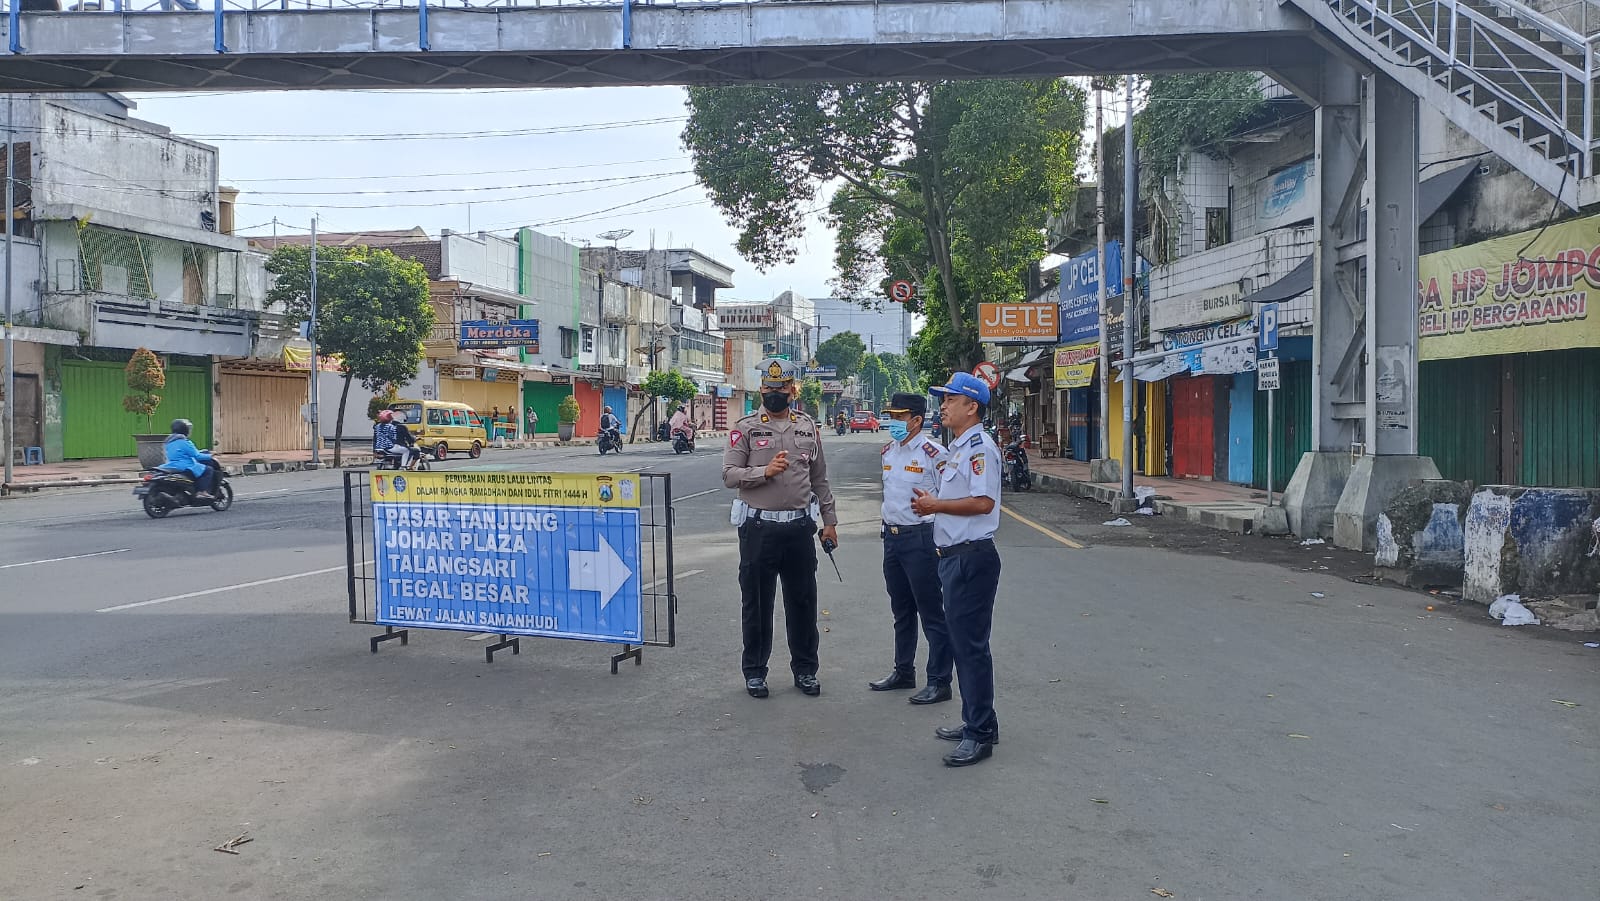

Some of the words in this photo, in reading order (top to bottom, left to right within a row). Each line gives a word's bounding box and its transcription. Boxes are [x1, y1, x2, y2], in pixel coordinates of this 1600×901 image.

[1068, 263, 1078, 290] JP
[1452, 267, 1487, 304] HP
[1203, 295, 1230, 311] BURSA
[1420, 312, 1446, 333] BELI
[1451, 309, 1469, 329] HP
[1473, 292, 1586, 326] BERGARANSI
[984, 306, 1053, 327] JETE
[1263, 310, 1276, 346] P
[467, 327, 531, 338] Merdeka
[1217, 323, 1241, 340] CELL
[445, 474, 486, 484] PERUBAHAN
[487, 475, 506, 484] ARUS
[507, 475, 525, 484] LALU
[527, 475, 552, 485] LINTAS
[416, 487, 439, 496] DALAM
[441, 487, 468, 496] RANGKA
[469, 488, 507, 497] RAMADHAN
[509, 488, 523, 497] DAN
[525, 489, 542, 498] IDUL
[543, 489, 562, 499] FITRI
[564, 489, 581, 499] 1444
[582, 490, 588, 499] H
[386, 509, 452, 529] PASAR
[457, 511, 558, 532] TANJUNG
[386, 530, 454, 550] JOHAR
[460, 533, 528, 554] PLAZA
[388, 554, 517, 578] TALANGSARI
[388, 578, 455, 600] TEGAL
[461, 582, 530, 604] BESAR
[389, 605, 432, 621] LEWAT
[435, 608, 475, 623] JALAN
[479, 612, 558, 630] SAMANHUDI
